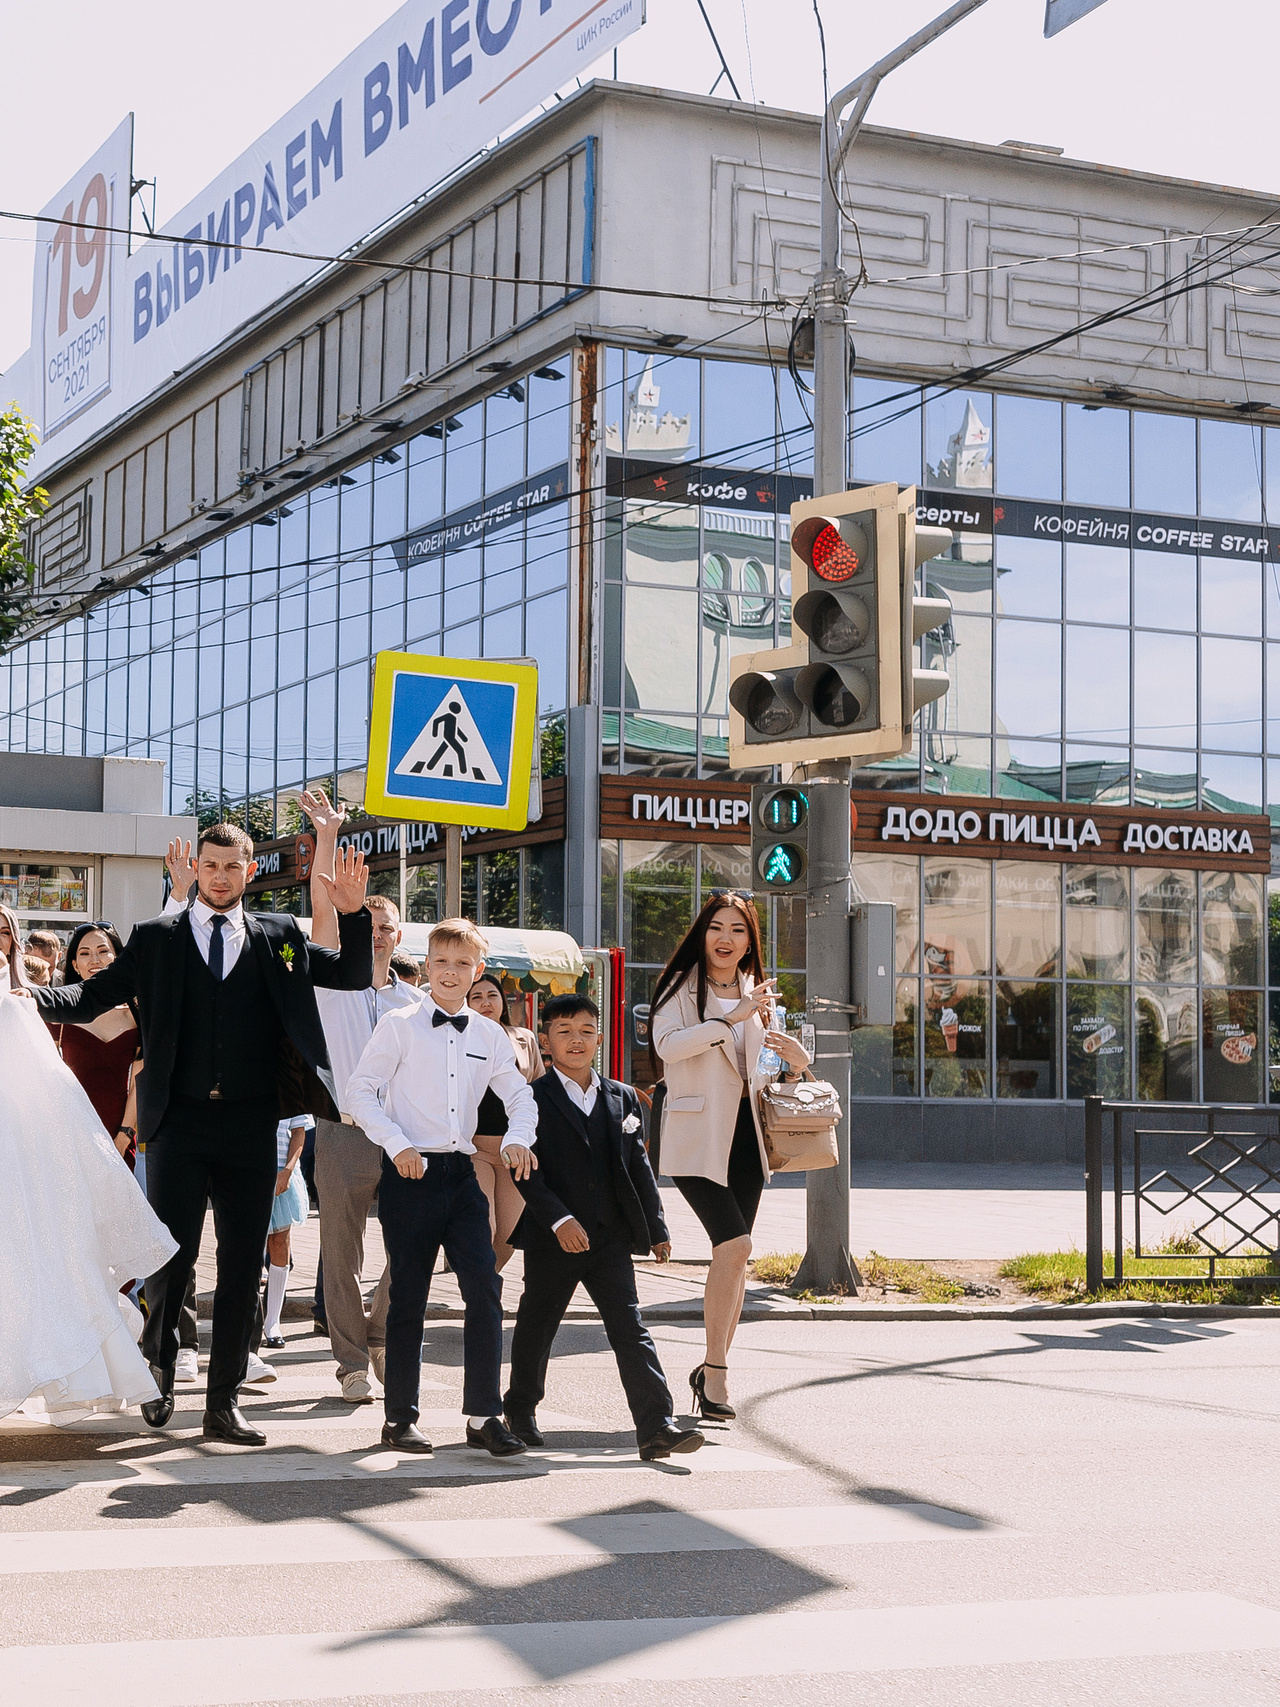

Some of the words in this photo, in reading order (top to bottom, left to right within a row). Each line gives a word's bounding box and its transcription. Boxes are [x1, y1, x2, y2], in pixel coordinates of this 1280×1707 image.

[577, 24, 597, 51] ЦИК
[133, 98, 343, 344] ВЫБИРАЕМ
[364, 0, 552, 158] ВМЕС
[52, 172, 108, 337] 19
[48, 315, 106, 384] СЕНТЯБРЯ
[63, 361, 90, 404] 2021
[463, 501, 513, 536] COFFEE
[516, 484, 550, 514] STAR
[686, 482, 747, 500] кофе
[915, 506, 980, 525] серты
[1034, 515, 1130, 541] КОФЕЙНЯ
[1137, 525, 1214, 549] COFFEE
[1220, 534, 1269, 554] STAR
[632, 793, 751, 829] ПИЦЦЕР
[882, 806, 982, 844] ДОДО
[989, 812, 1101, 852] ПИЦЦА
[1124, 823, 1254, 854] ДОСТАВКА
[252, 852, 280, 876] ЕРИЯ
